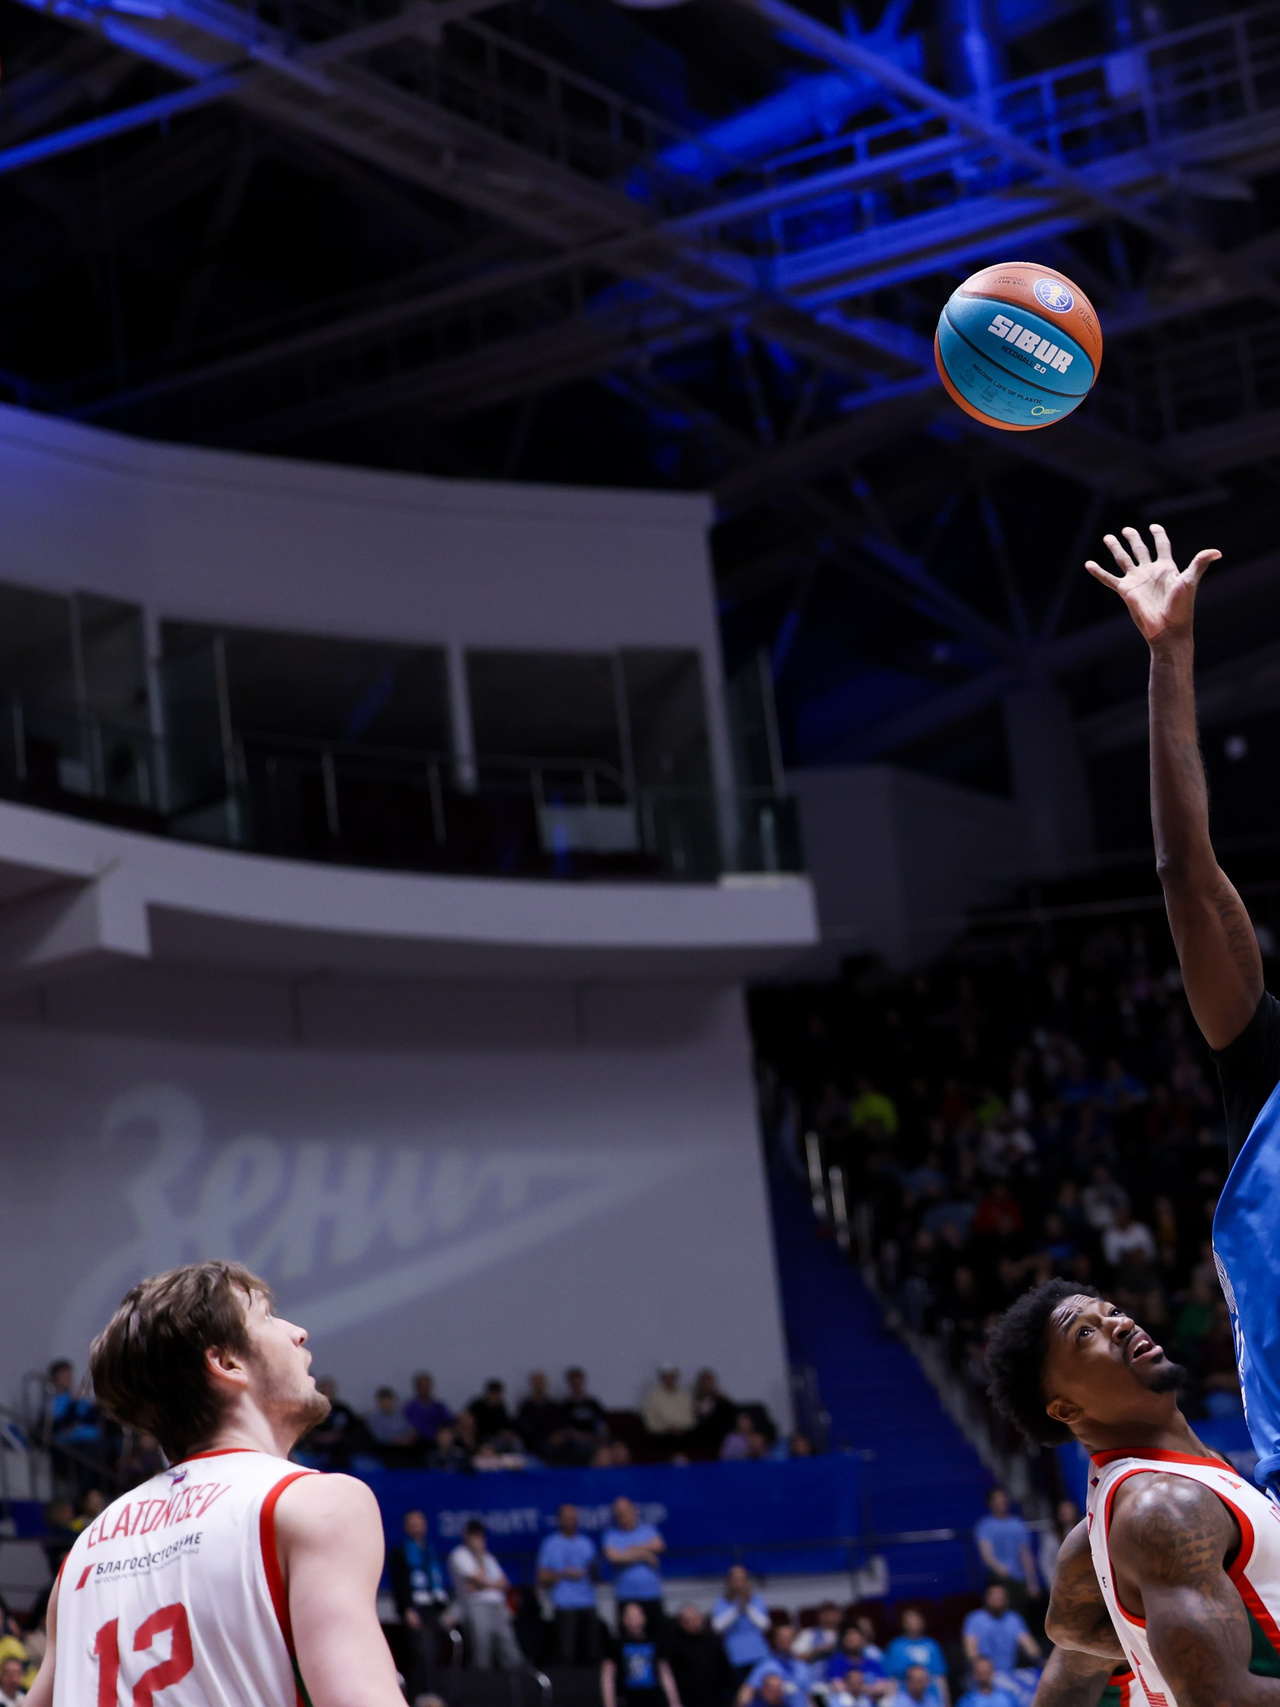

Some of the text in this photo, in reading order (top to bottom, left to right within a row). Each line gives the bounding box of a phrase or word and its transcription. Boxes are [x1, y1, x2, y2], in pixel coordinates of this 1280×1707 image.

[988, 314, 1074, 374] SIBUR
[1033, 363, 1047, 374] 2.0
[972, 363, 994, 382] SECOND
[993, 381, 1008, 392] LIFE
[1016, 393, 1043, 405] PLASTIC
[87, 1483, 232, 1550] ELATONTSEV
[93, 1602, 195, 1707] 12
